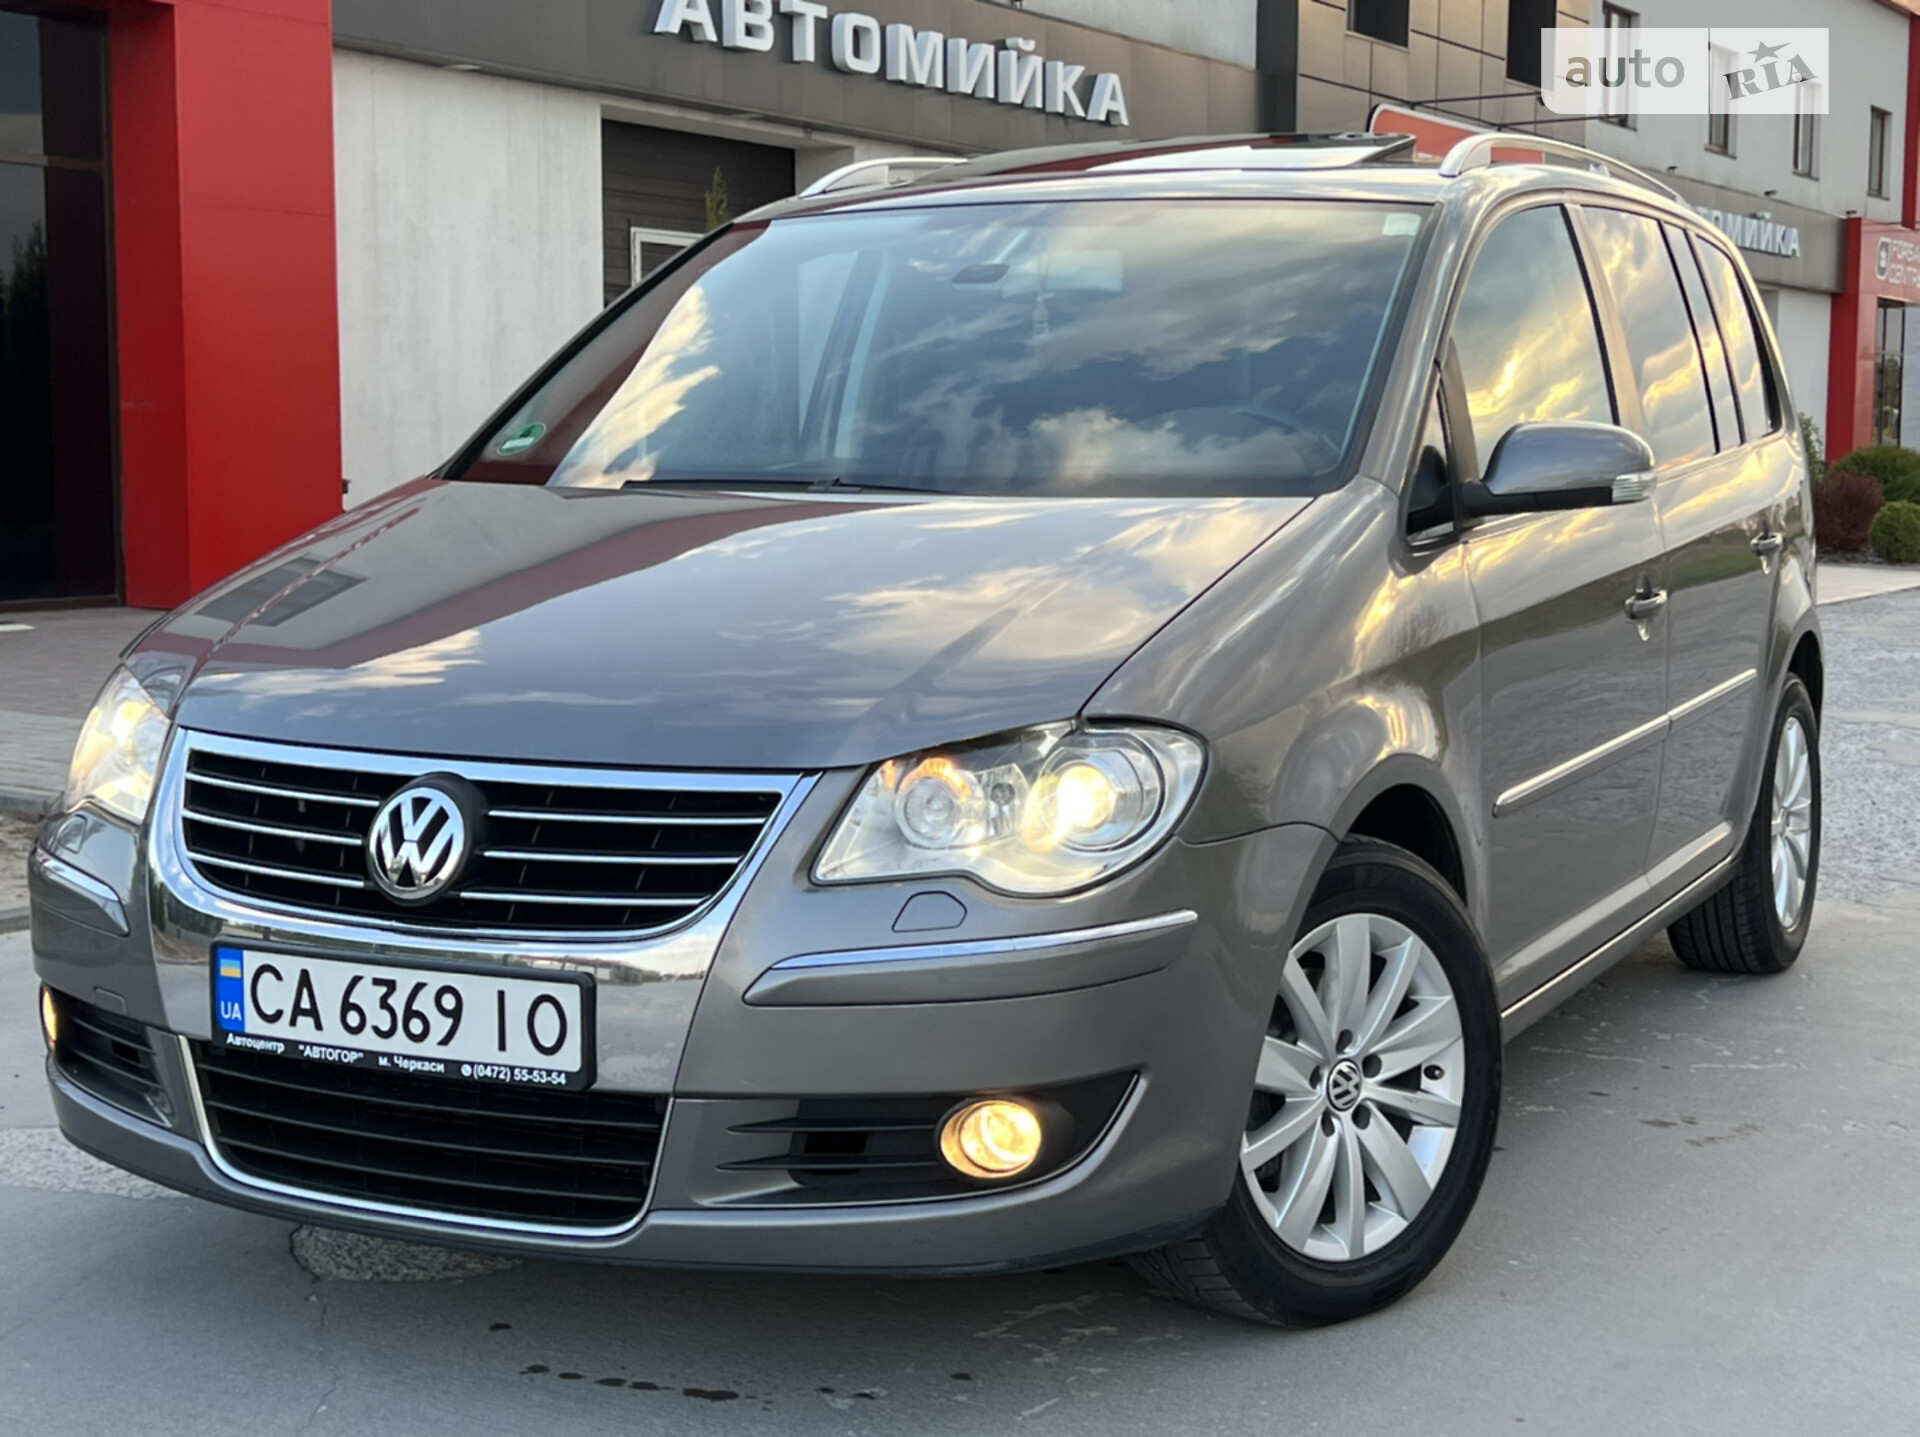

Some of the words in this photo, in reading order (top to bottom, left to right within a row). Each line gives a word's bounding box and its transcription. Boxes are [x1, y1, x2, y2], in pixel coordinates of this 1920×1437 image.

[654, 0, 1129, 126] АВТОМИЙКА
[220, 1001, 242, 1021] UA
[250, 964, 323, 1031] CA
[340, 975, 463, 1046] 6369
[226, 1032, 285, 1054] Автоцентр
[298, 1045, 364, 1064] "АВТОГОР"
[378, 1056, 391, 1067] м.
[394, 1056, 445, 1073] Черкаси
[473, 1064, 511, 1082] (0472)
[513, 1069, 566, 1085] 55-53-54
